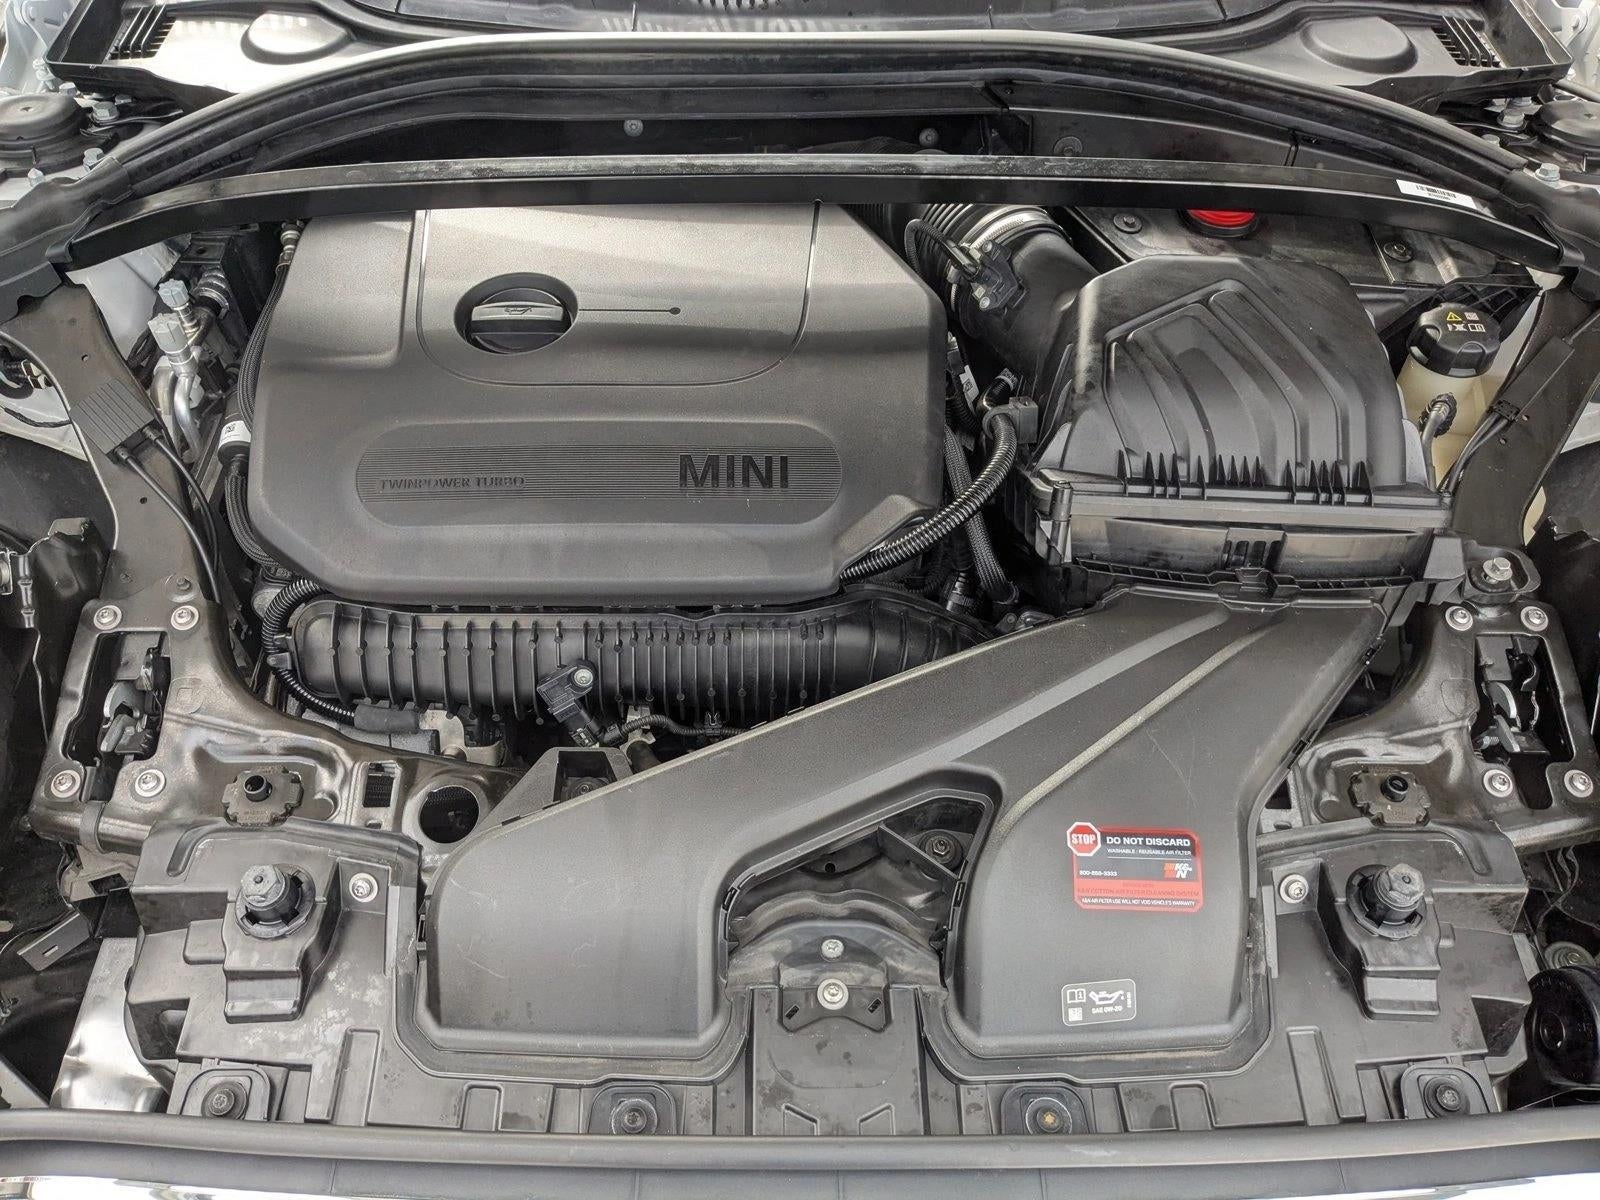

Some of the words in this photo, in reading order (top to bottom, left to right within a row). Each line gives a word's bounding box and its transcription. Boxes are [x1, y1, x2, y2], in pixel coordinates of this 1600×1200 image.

[679, 454, 789, 489] MINI
[380, 477, 470, 490] TWINPOWER
[476, 476, 525, 488] TURBO
[1071, 833, 1096, 845] STOP
[1106, 836, 1121, 844] DO
[1123, 837, 1144, 845] NOT
[1146, 837, 1191, 847] DISCARD
